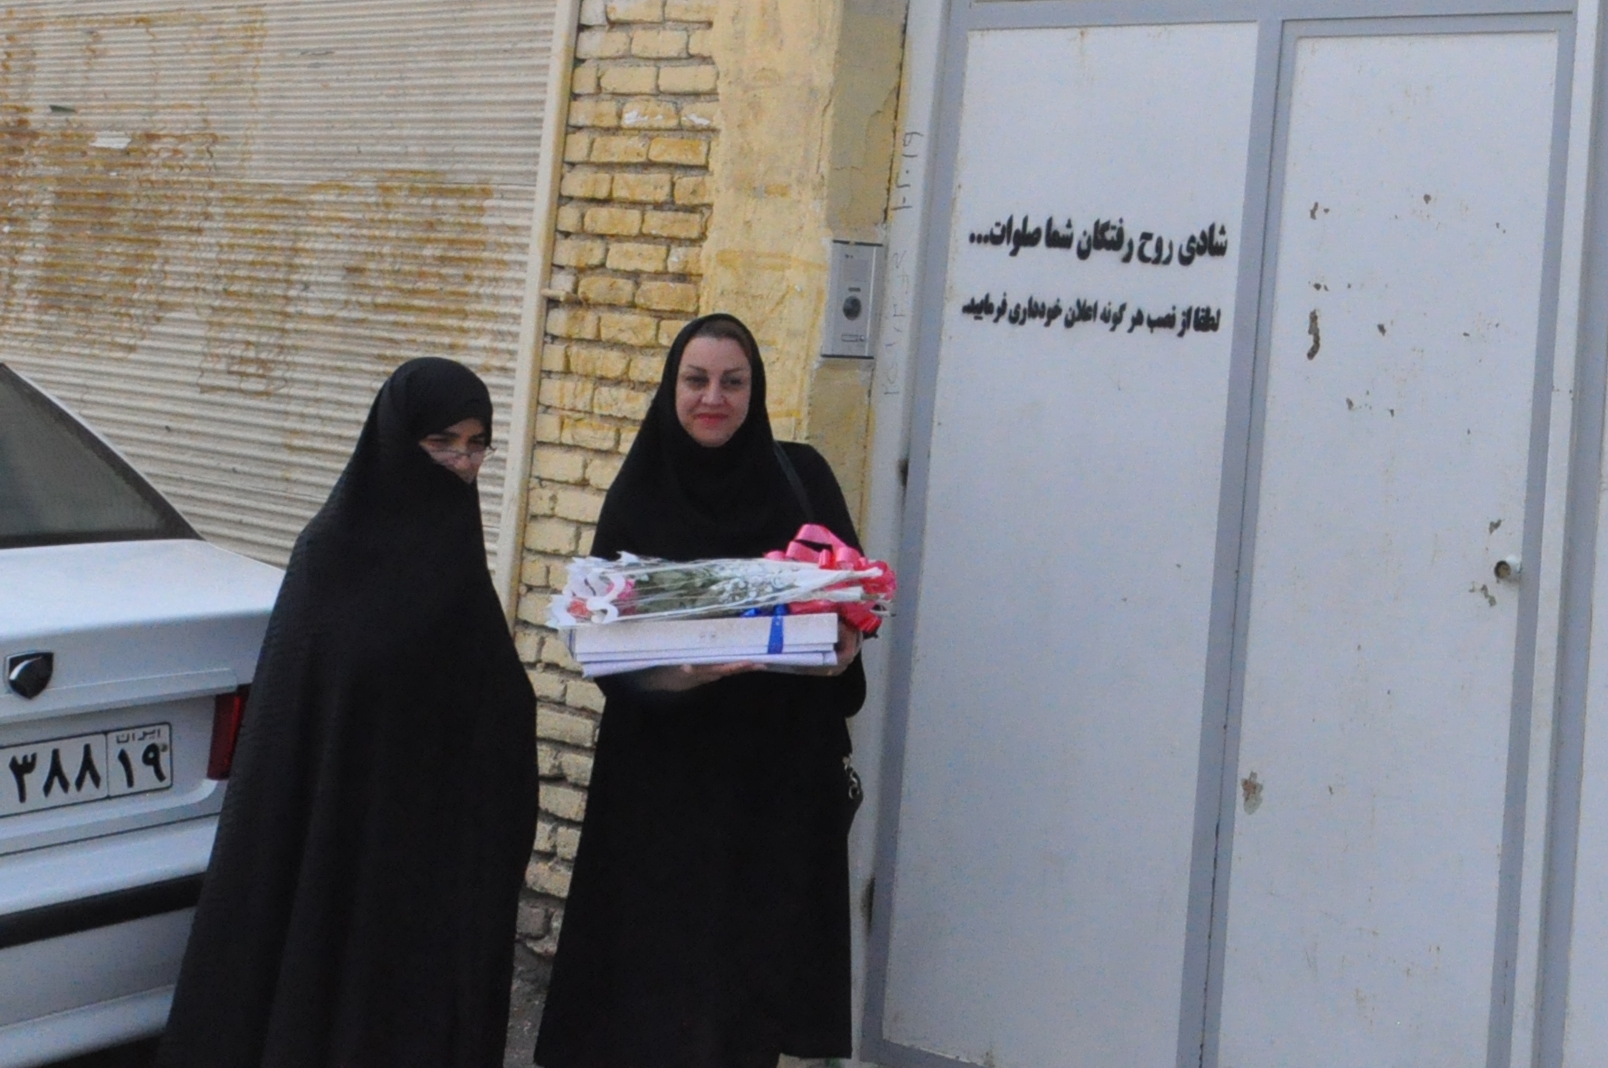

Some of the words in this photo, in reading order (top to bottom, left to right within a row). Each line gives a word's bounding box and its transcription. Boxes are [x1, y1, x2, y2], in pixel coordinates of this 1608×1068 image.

[1045, 216, 1074, 249] شما
[1076, 217, 1134, 263] رفتگان
[1137, 231, 1174, 265] روح
[1177, 222, 1228, 266] شادی
[1008, 295, 1063, 328] خودداری
[1064, 297, 1098, 328] اعلان
[1099, 301, 1127, 332] گونه
[1127, 307, 1144, 333] هر
[1146, 304, 1177, 334] نصب
[1177, 305, 1193, 337] از
[116, 728, 161, 744] ایران
[8, 743, 102, 804] ۳۸۸
[117, 742, 167, 789] ۱۹
